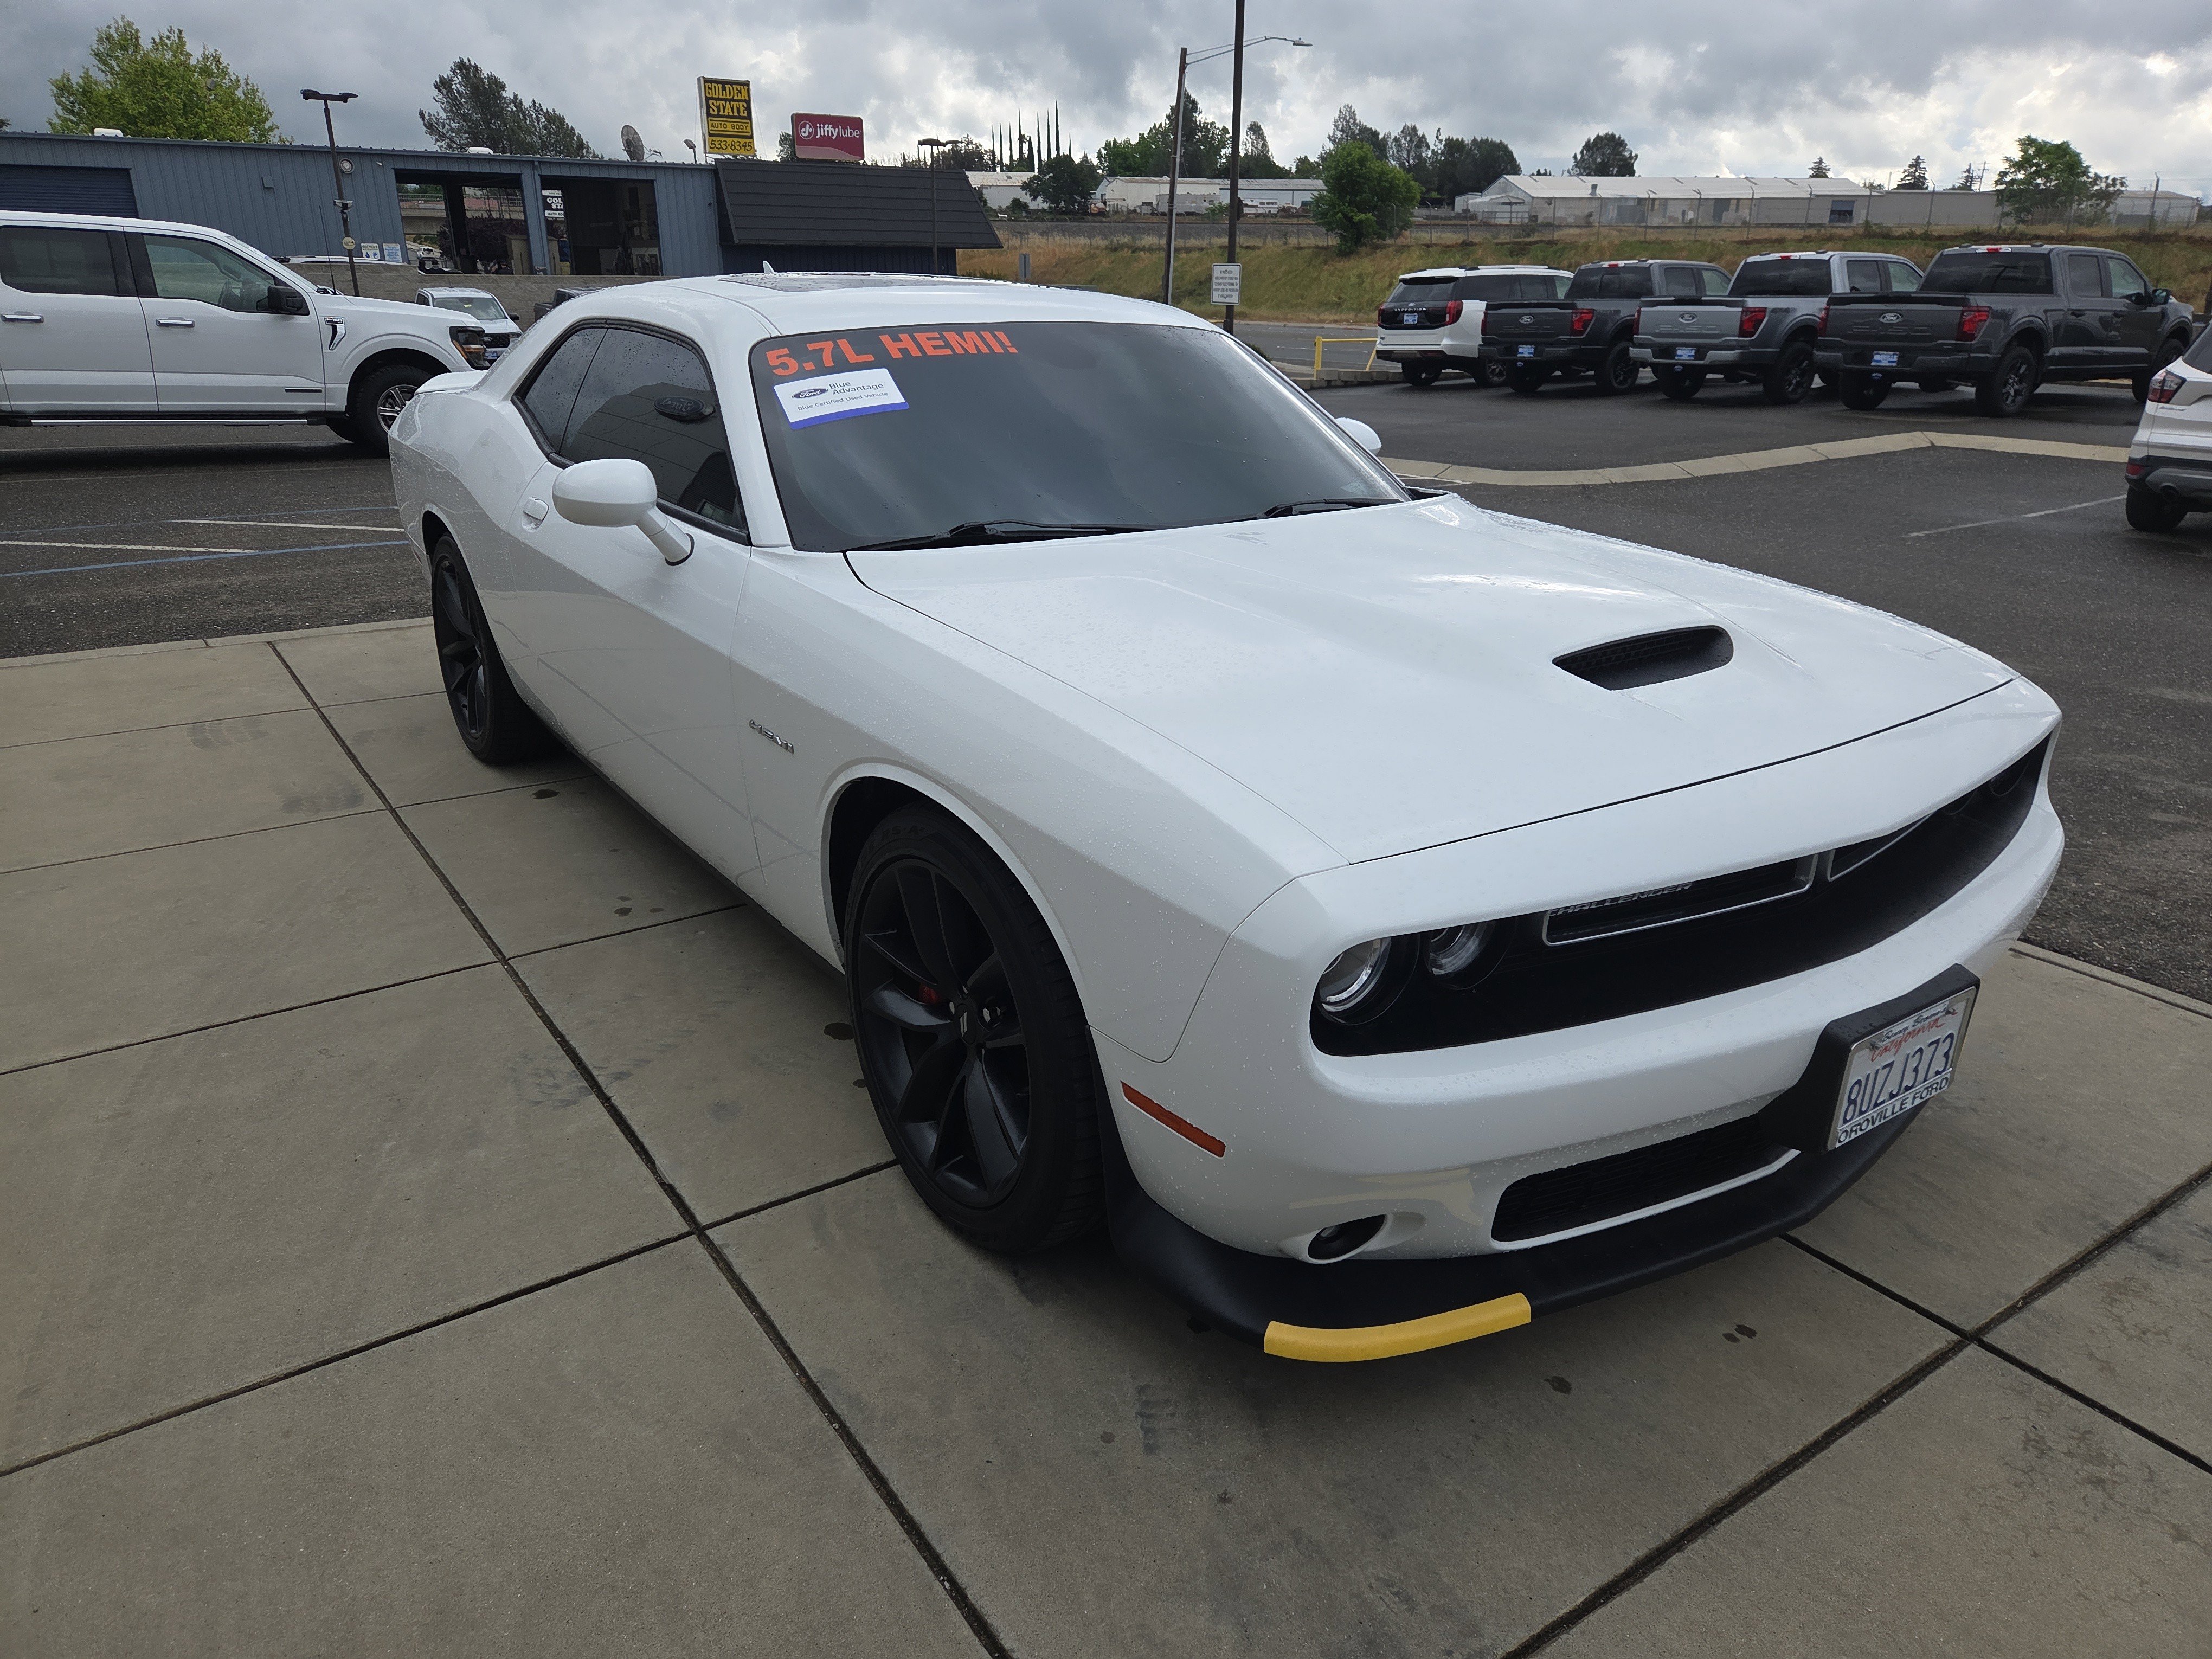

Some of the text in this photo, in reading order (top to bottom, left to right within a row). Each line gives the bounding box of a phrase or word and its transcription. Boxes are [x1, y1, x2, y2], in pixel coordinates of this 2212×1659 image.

[705, 82, 749, 100] GOLDEN
[709, 100, 748, 117] STATE
[766, 331, 1018, 376] 5.7L HEMI!
[799, 389, 821, 398] Ford
[833, 383, 884, 395] Advantage
[815, 398, 844, 407] Certified
[1549, 882, 1692, 917] CHALLENGER
[1843, 1032, 1954, 1124] 8UZJ373
[1838, 1076, 1949, 1144] OROVILLE FORD
